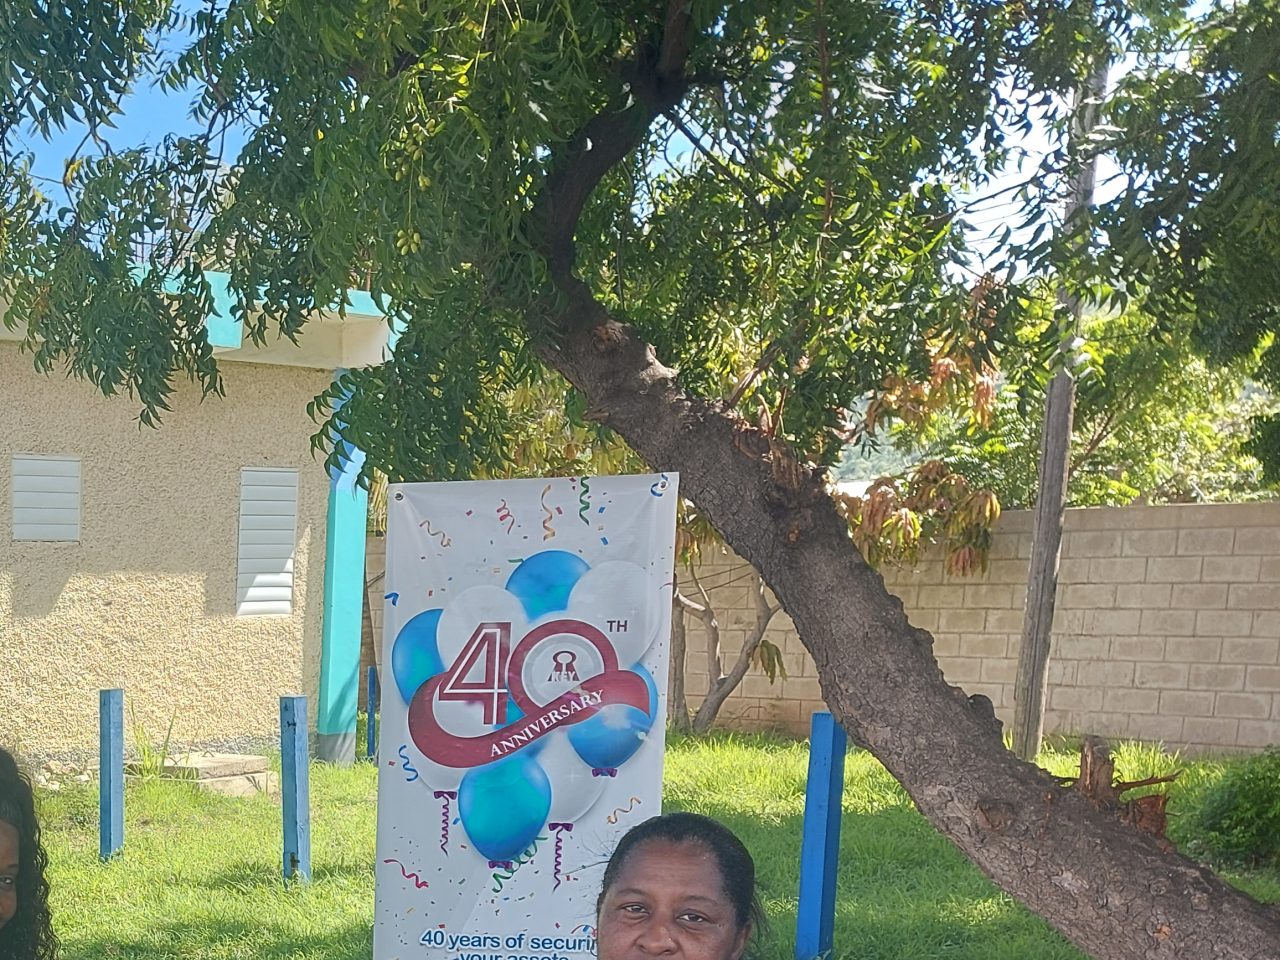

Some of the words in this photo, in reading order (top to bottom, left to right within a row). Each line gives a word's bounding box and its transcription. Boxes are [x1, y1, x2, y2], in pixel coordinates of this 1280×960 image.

[438, 619, 619, 725] 40
[607, 620, 628, 632] TH
[490, 689, 604, 757] ANNIVERSARY
[421, 930, 445, 946] 40
[448, 934, 501, 950] years
[505, 933, 526, 949] of
